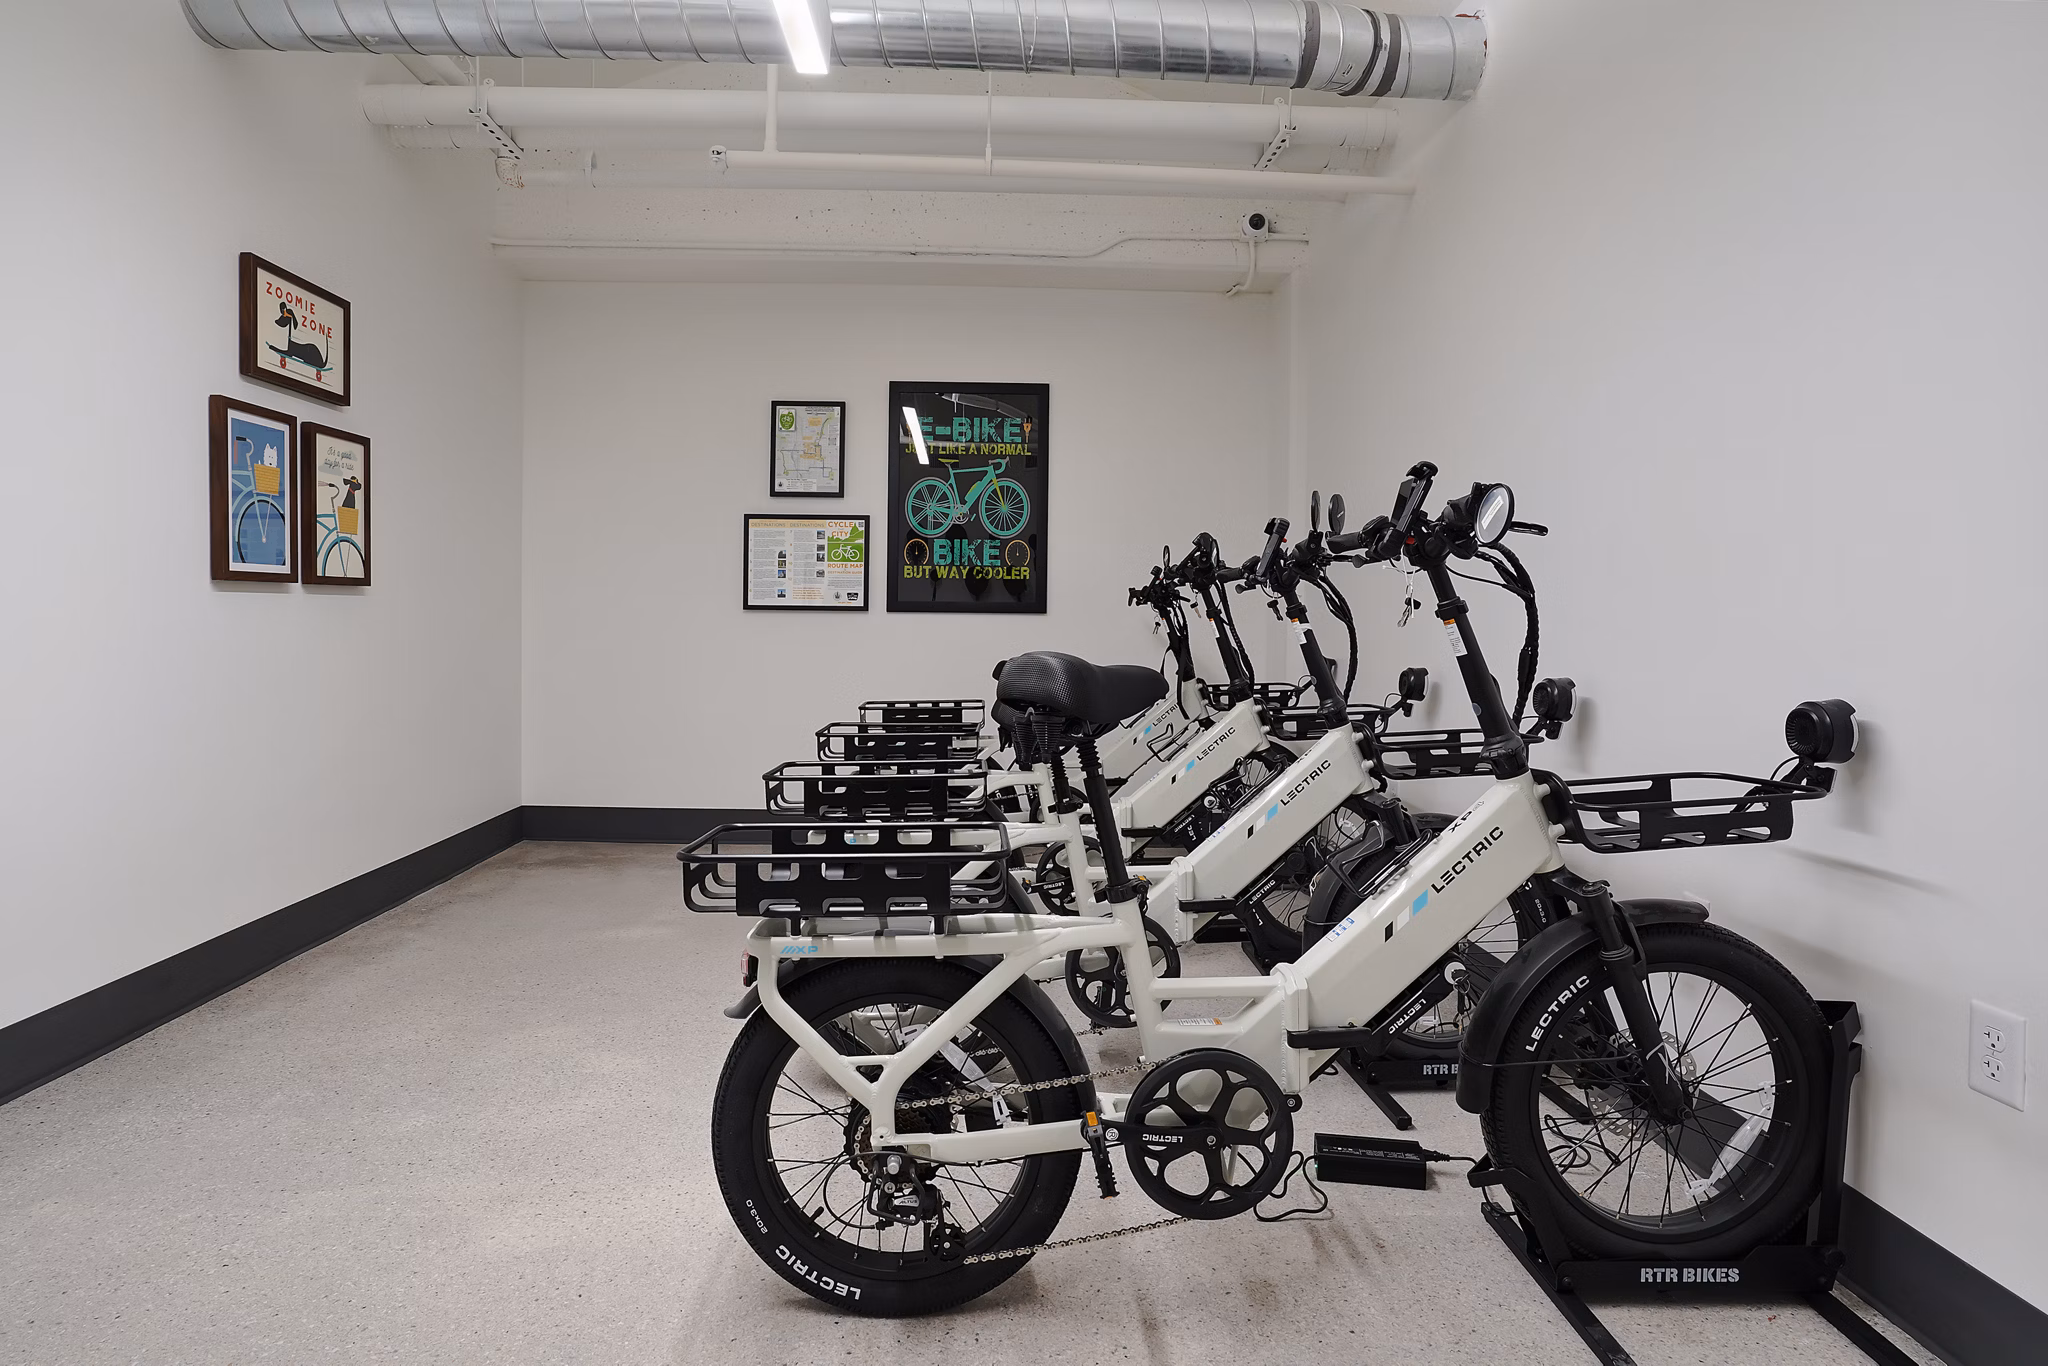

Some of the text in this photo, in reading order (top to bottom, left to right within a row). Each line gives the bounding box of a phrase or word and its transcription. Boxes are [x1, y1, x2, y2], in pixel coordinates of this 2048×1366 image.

[266, 281, 315, 315] ZOOMIE
[301, 315, 333, 339] ZONE
[917, 416, 1022, 442] E-BIKE
[905, 443, 1032, 456] JT LIKE A NORMAL
[933, 539, 1001, 566] BIKE
[903, 565, 1030, 579] BUT WAY COOLER
[1152, 703, 1178, 727] LECTRI
[1196, 727, 1236, 761] LECTRIC
[1280, 760, 1331, 806] LECTRIC
[1431, 826, 1504, 894] LECTRIC
[1249, 879, 1276, 905] LECTRIC
[1388, 998, 1427, 1035] LECTRIC
[1525, 975, 1590, 1052] LECTRIC
[1422, 1064, 1449, 1075] RTR
[1142, 1133, 1184, 1143] LECTRIC
[775, 1244, 862, 1300] LECTRIC
[1640, 1267, 1740, 1283] RTR BIKES
